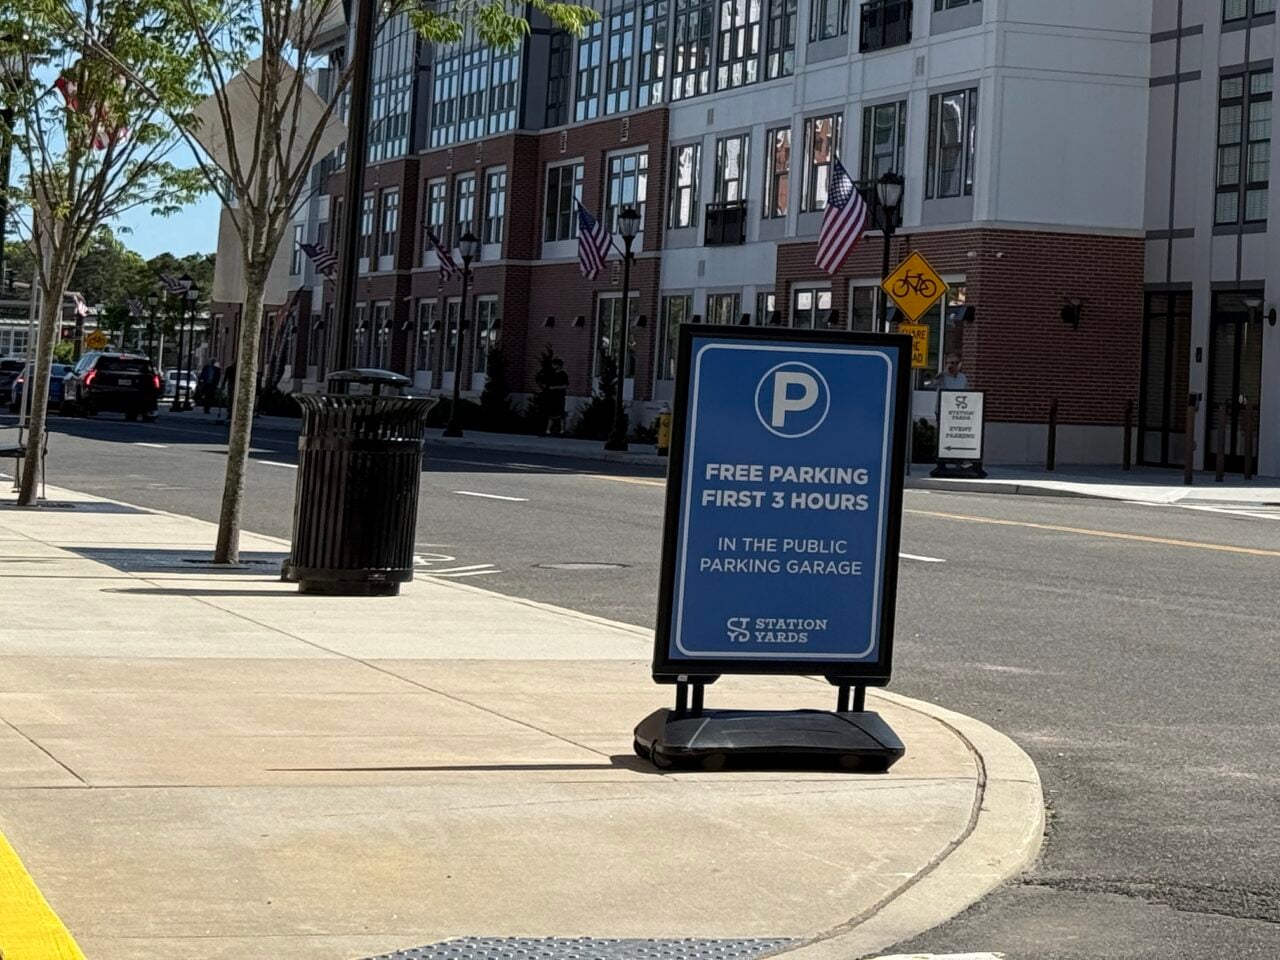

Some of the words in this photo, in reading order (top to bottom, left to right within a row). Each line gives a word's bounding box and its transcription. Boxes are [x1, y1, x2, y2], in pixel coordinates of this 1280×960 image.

[772, 371, 819, 427] P
[705, 464, 763, 482] FREE
[769, 466, 868, 485] PARKING
[701, 490, 766, 508] FIRST
[771, 491, 785, 509] 3
[791, 493, 869, 511] HOURS
[718, 537, 736, 551] IN
[742, 538, 777, 552] THE
[783, 539, 847, 554] PUBLIC
[700, 558, 781, 573] PARKING
[786, 560, 862, 575] GARAGE
[755, 618, 828, 630] STATION
[754, 631, 808, 643] YARDS
